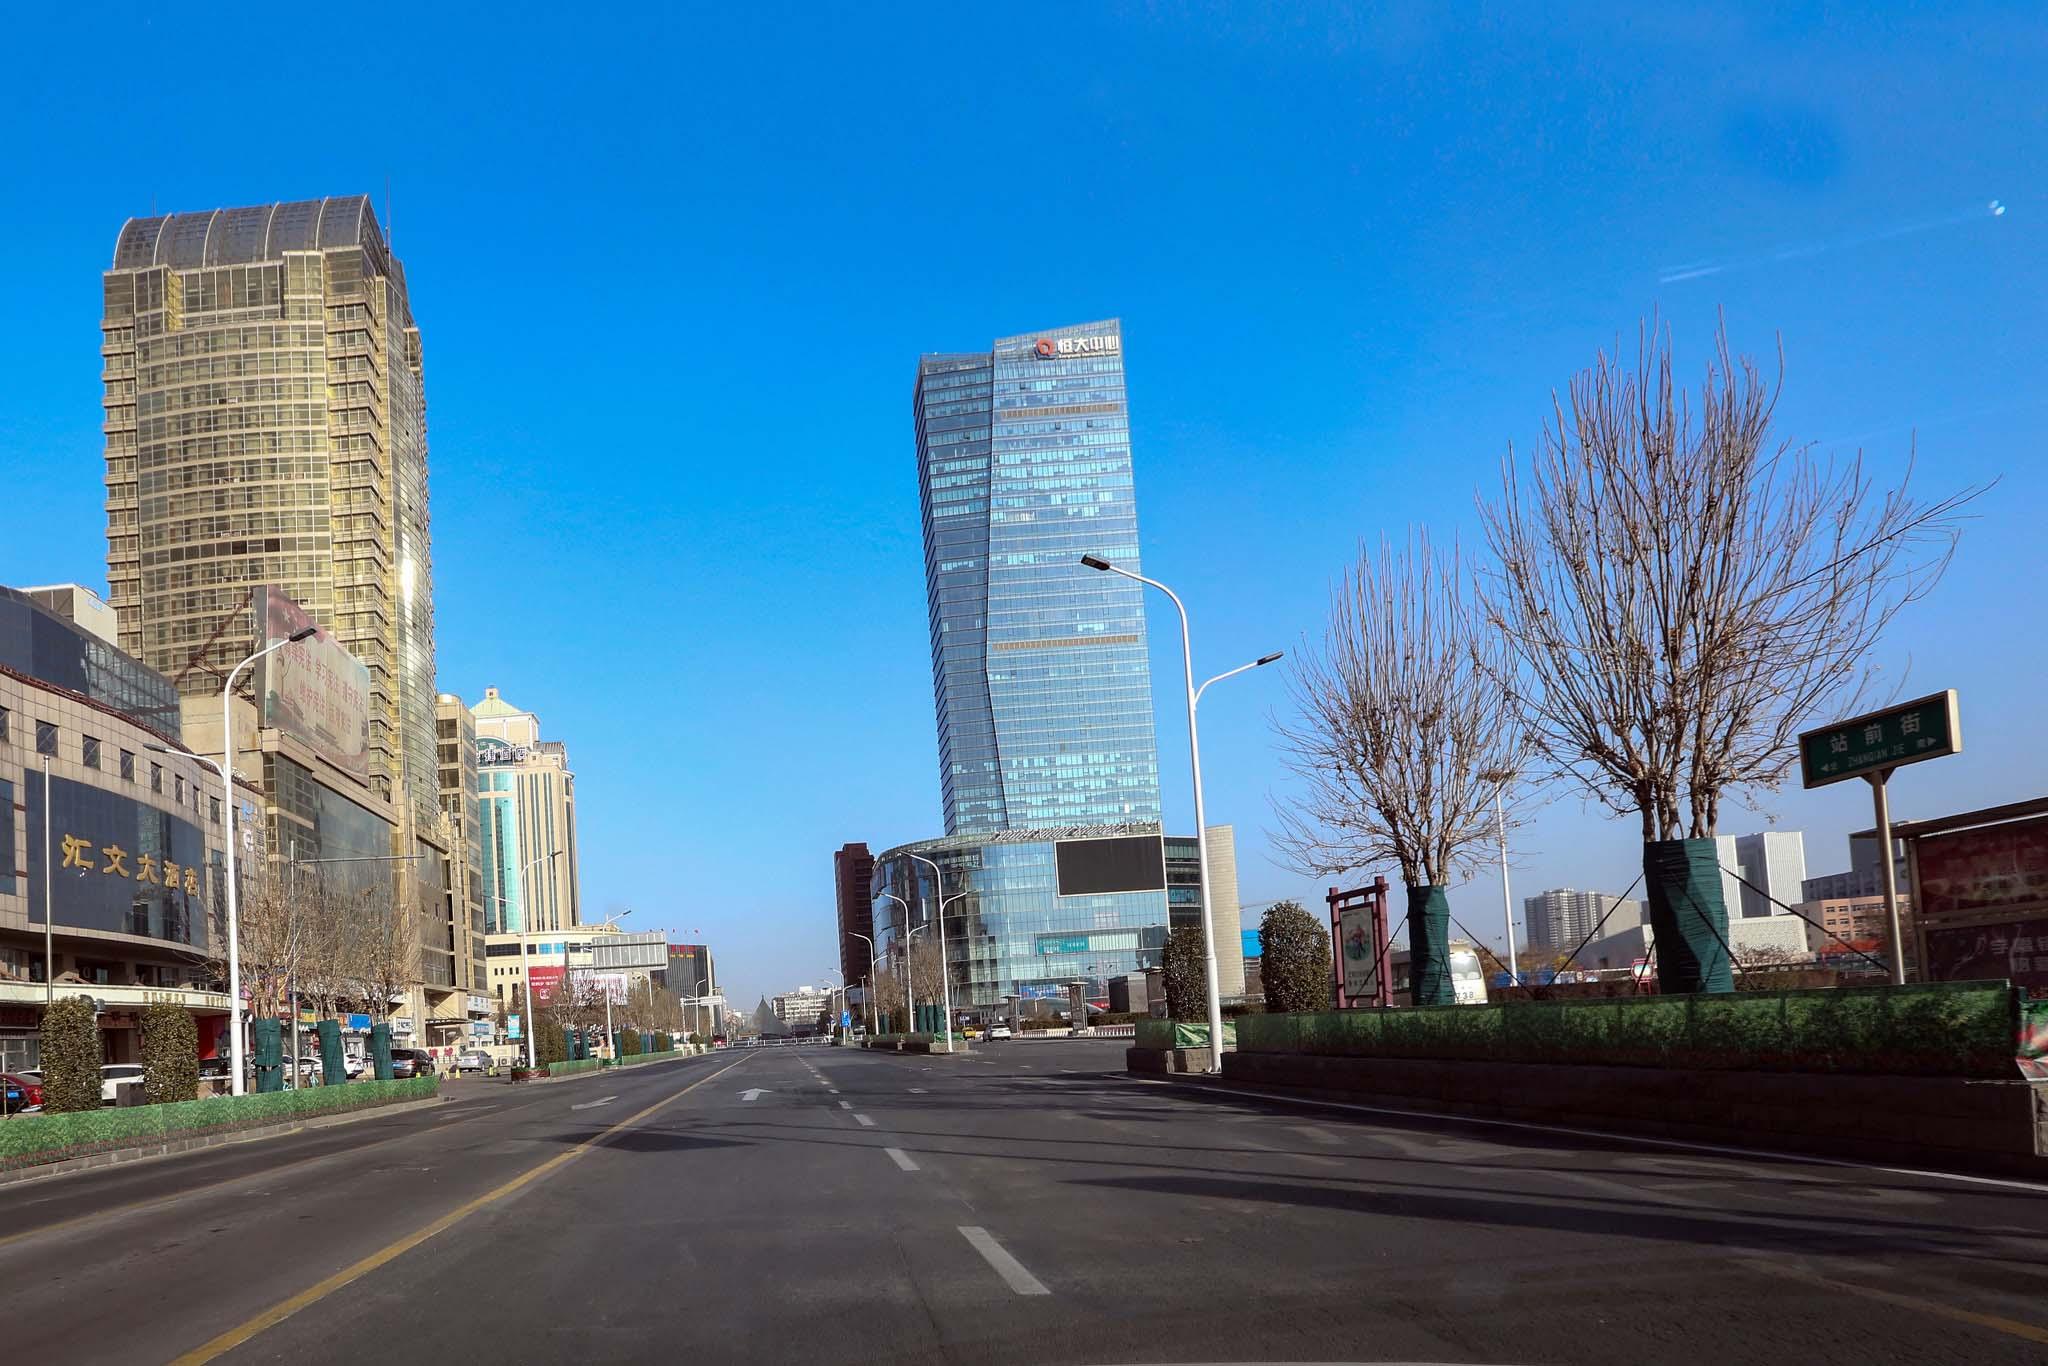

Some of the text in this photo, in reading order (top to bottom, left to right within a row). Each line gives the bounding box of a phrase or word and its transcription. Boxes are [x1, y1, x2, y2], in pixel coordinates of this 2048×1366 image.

[1057, 335, 1119, 353] 恒大中心
[1829, 712, 1921, 754] 站前街
[62, 832, 198, 897] 汇文大酒店
